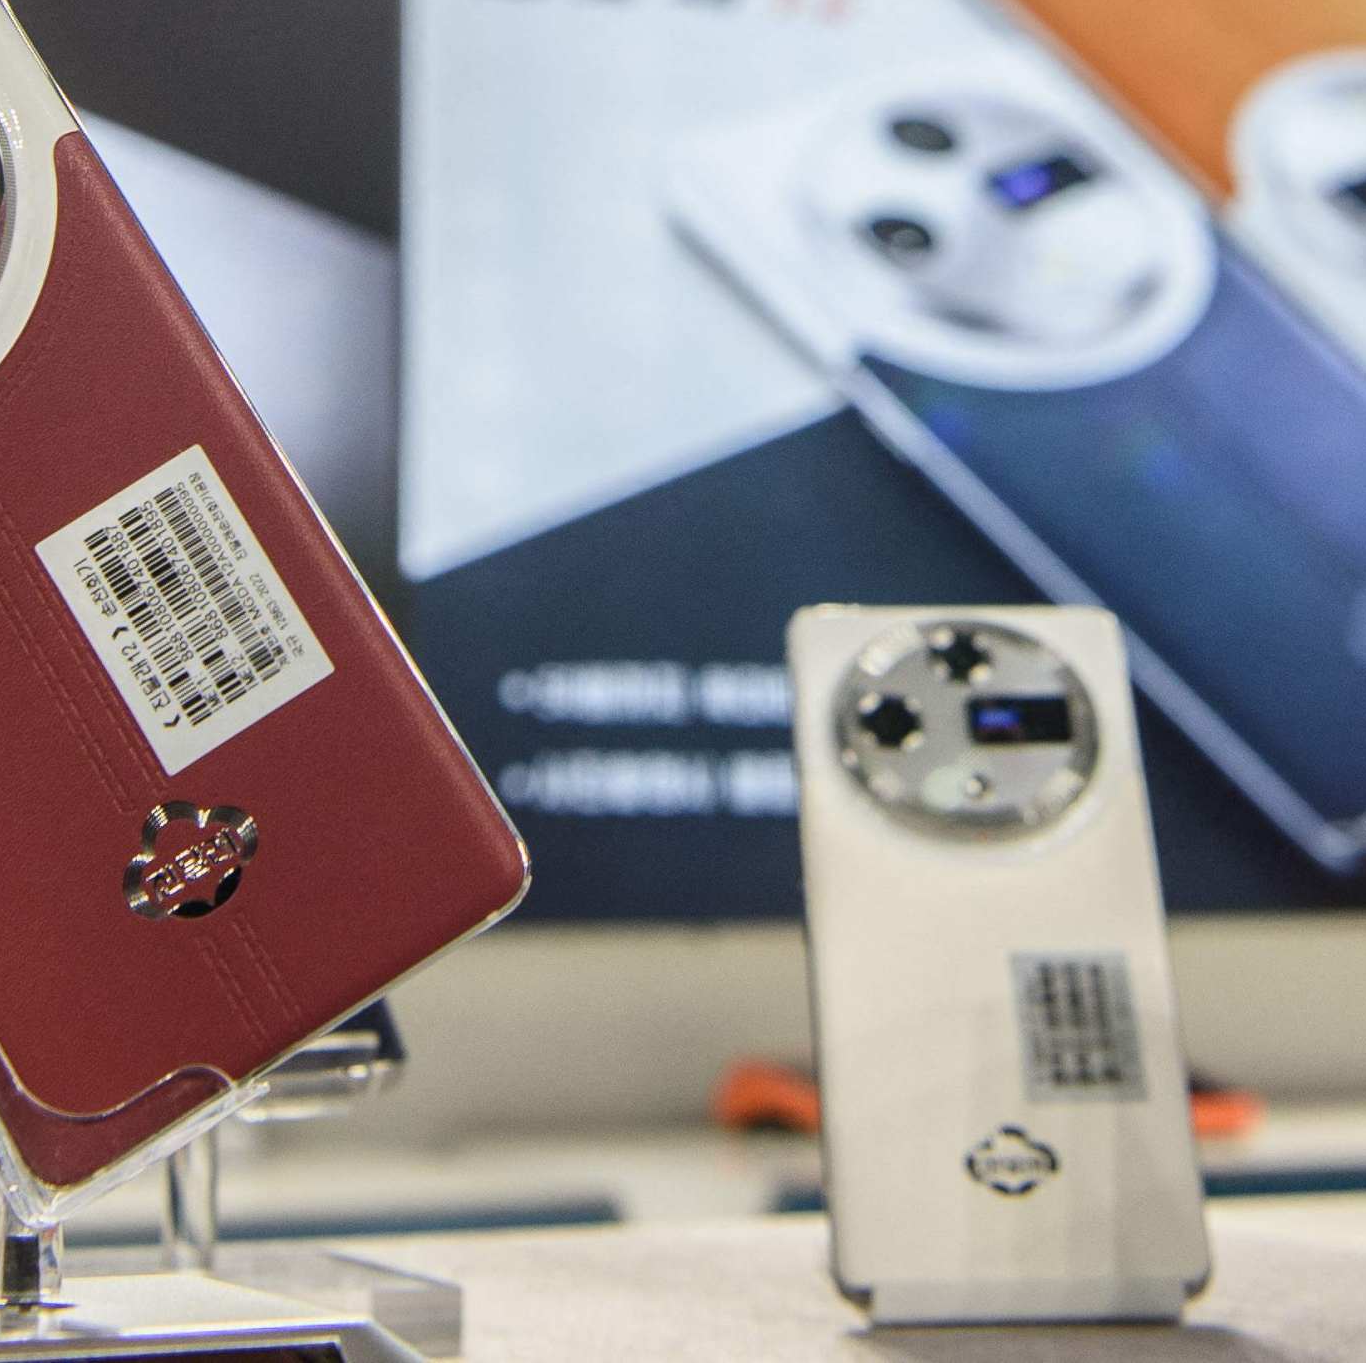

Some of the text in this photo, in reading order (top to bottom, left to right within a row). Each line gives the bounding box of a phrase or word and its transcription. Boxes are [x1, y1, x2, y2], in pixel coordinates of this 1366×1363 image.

[71, 555, 119, 620] 손전화기
[103, 520, 195, 663] 868108067401887
[137, 498, 230, 641] 868108067401895
